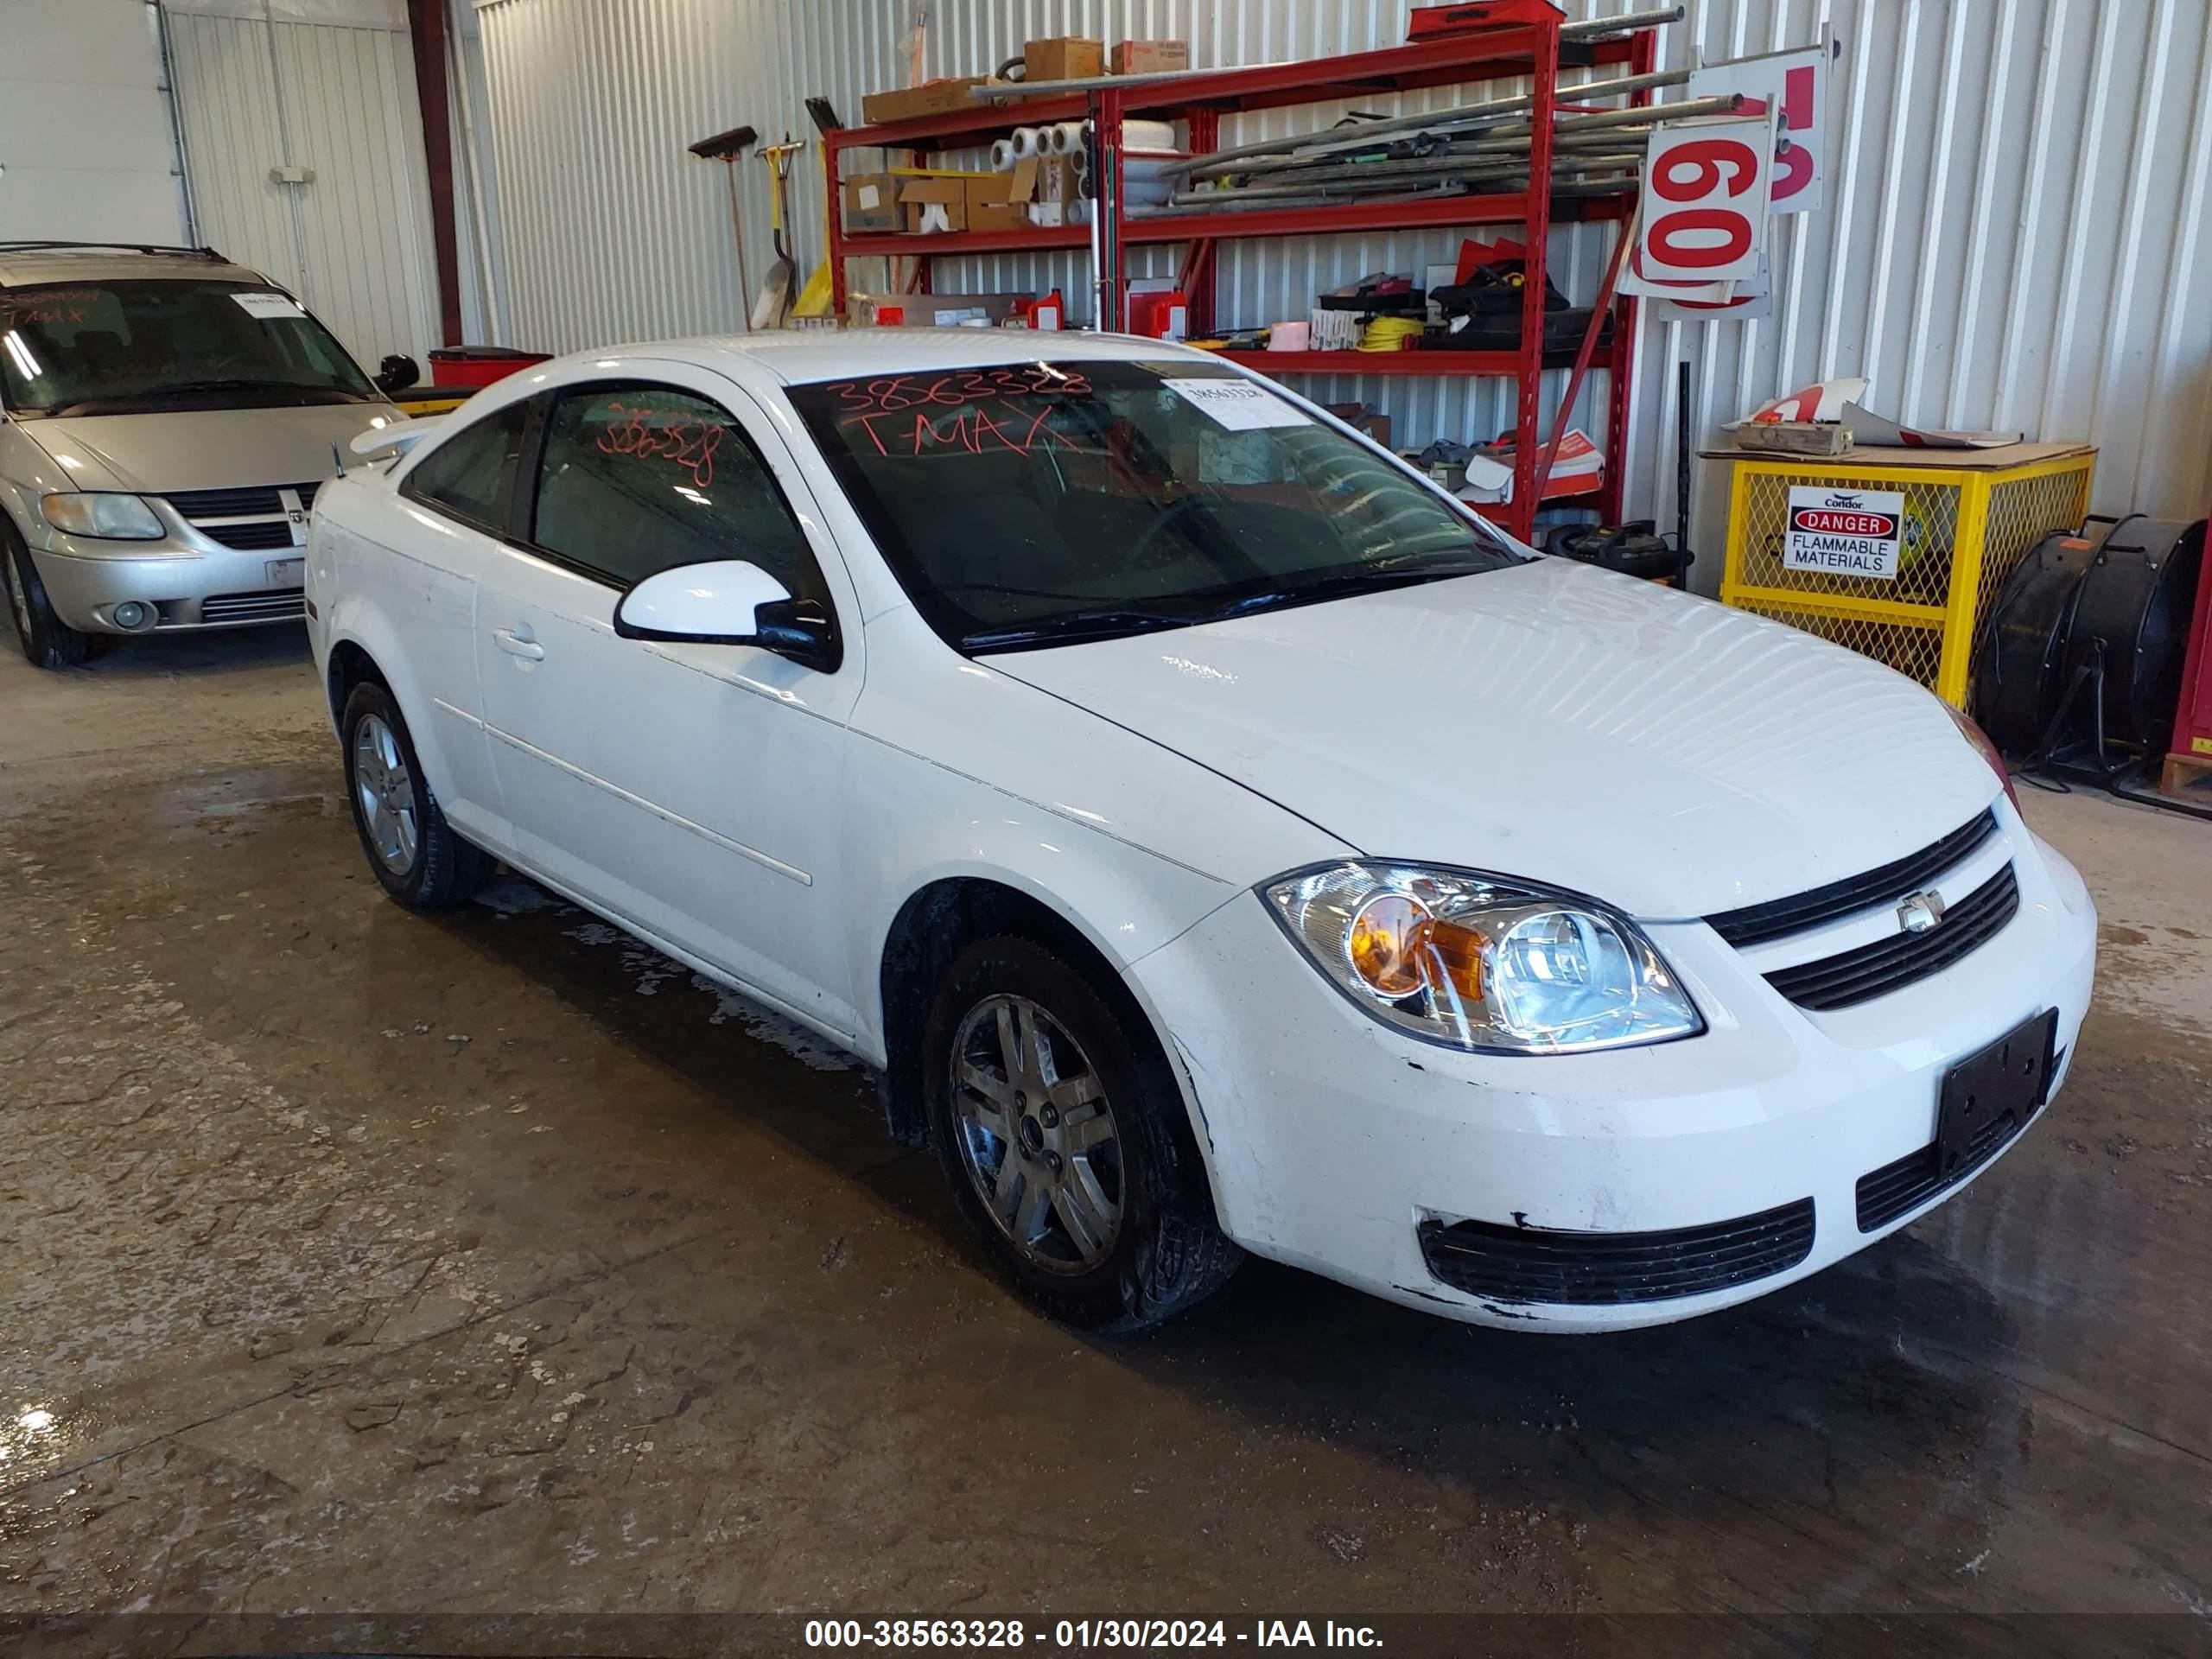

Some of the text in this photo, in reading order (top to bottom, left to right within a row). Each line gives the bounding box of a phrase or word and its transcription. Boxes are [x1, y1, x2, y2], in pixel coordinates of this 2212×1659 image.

[1648, 139, 1758, 269] 60
[828, 370, 1092, 410] 38563328
[840, 399, 1084, 457] T-MAX
[1808, 513, 1880, 533] DANGER
[1793, 535, 1889, 556] FLAMMABLE
[1796, 550, 1883, 571] MATERIALS
